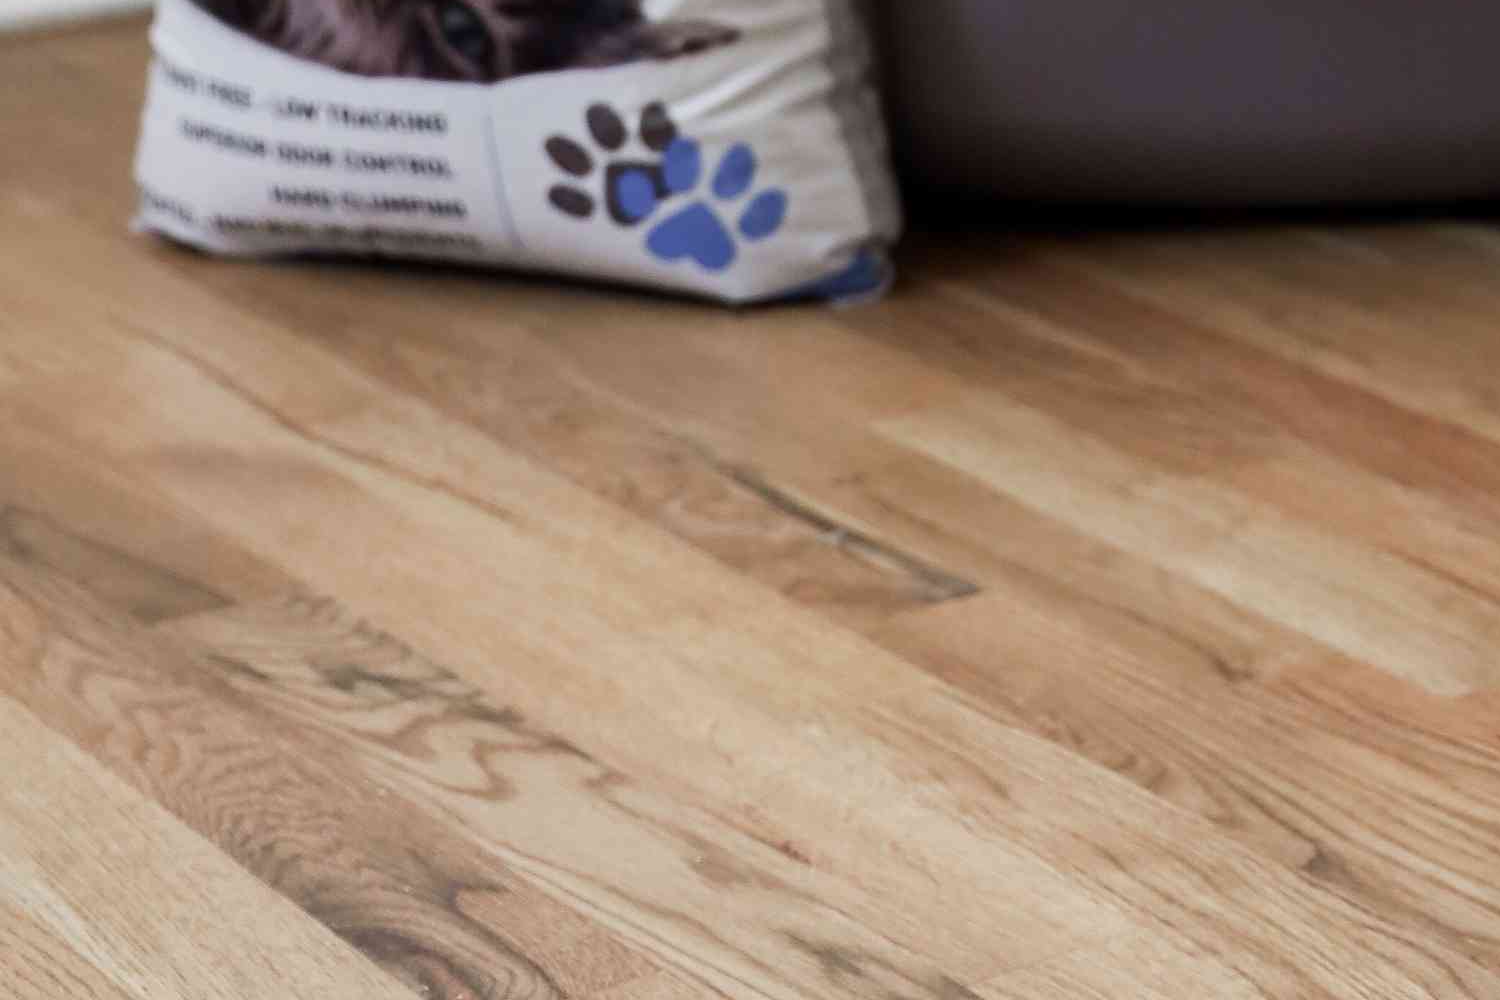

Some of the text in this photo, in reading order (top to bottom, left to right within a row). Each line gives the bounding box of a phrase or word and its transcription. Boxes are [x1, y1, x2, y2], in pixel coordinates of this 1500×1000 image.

[328, 104, 449, 134] TRACKING
[179, 119, 267, 160] SUPERIOR
[343, 148, 454, 180] CONTROL
